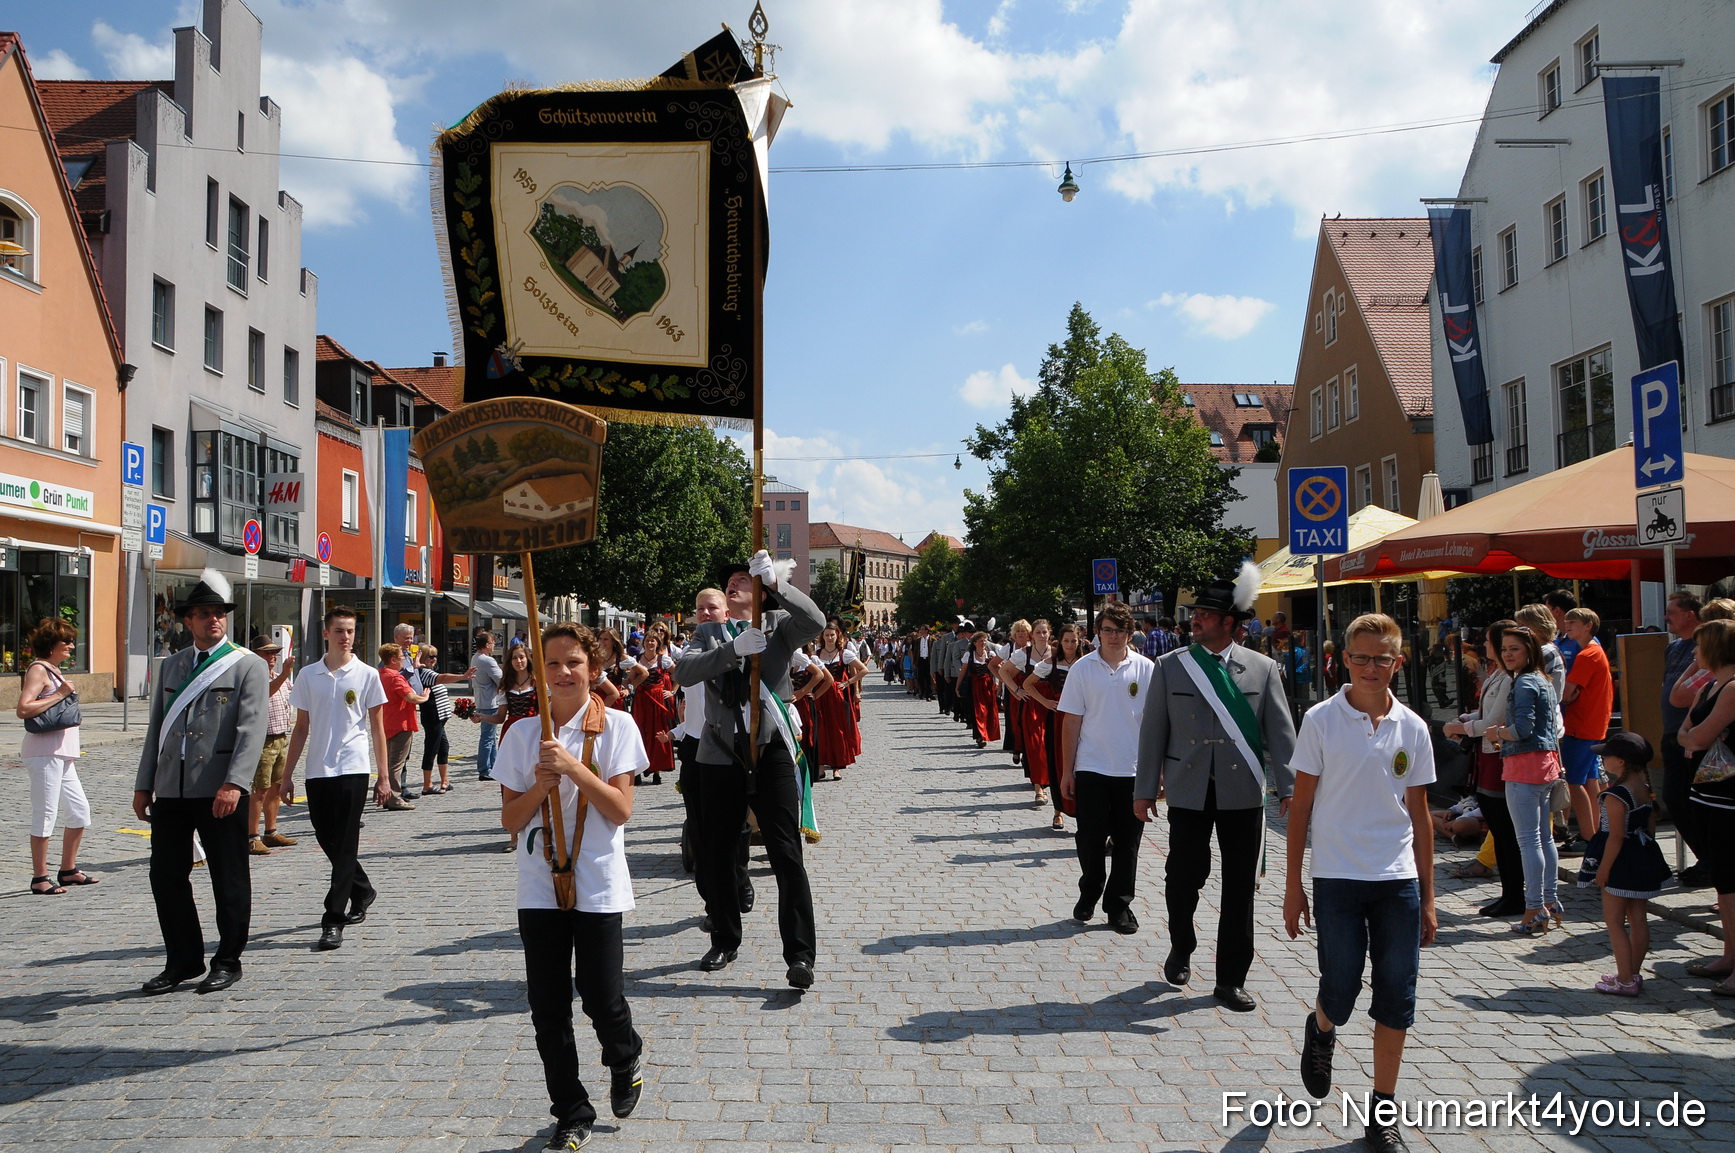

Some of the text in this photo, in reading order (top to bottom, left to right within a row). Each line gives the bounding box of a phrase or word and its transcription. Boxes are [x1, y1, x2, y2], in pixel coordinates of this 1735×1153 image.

[539, 108, 657, 127] Schützenverein
[513, 168, 537, 194] 1959
[1619, 184, 1664, 276] K&L
[522, 276, 580, 337] Holzheim
[656, 315, 685, 342] 1963
[1443, 292, 1478, 363] K&L
[1640, 380, 1669, 449] P
[127, 448, 140, 479] P
[43, 488, 63, 507] Grün
[66, 493, 88, 512] Punkt
[268, 481, 301, 504] H&M
[1651, 495, 1667, 507] nur
[150, 509, 162, 538] P
[451, 518, 586, 551] HOLZHEIM
[1295, 528, 1342, 547] TAXI
[1400, 549, 1415, 561] Hotel
[1096, 583, 1116, 591] TAXI
